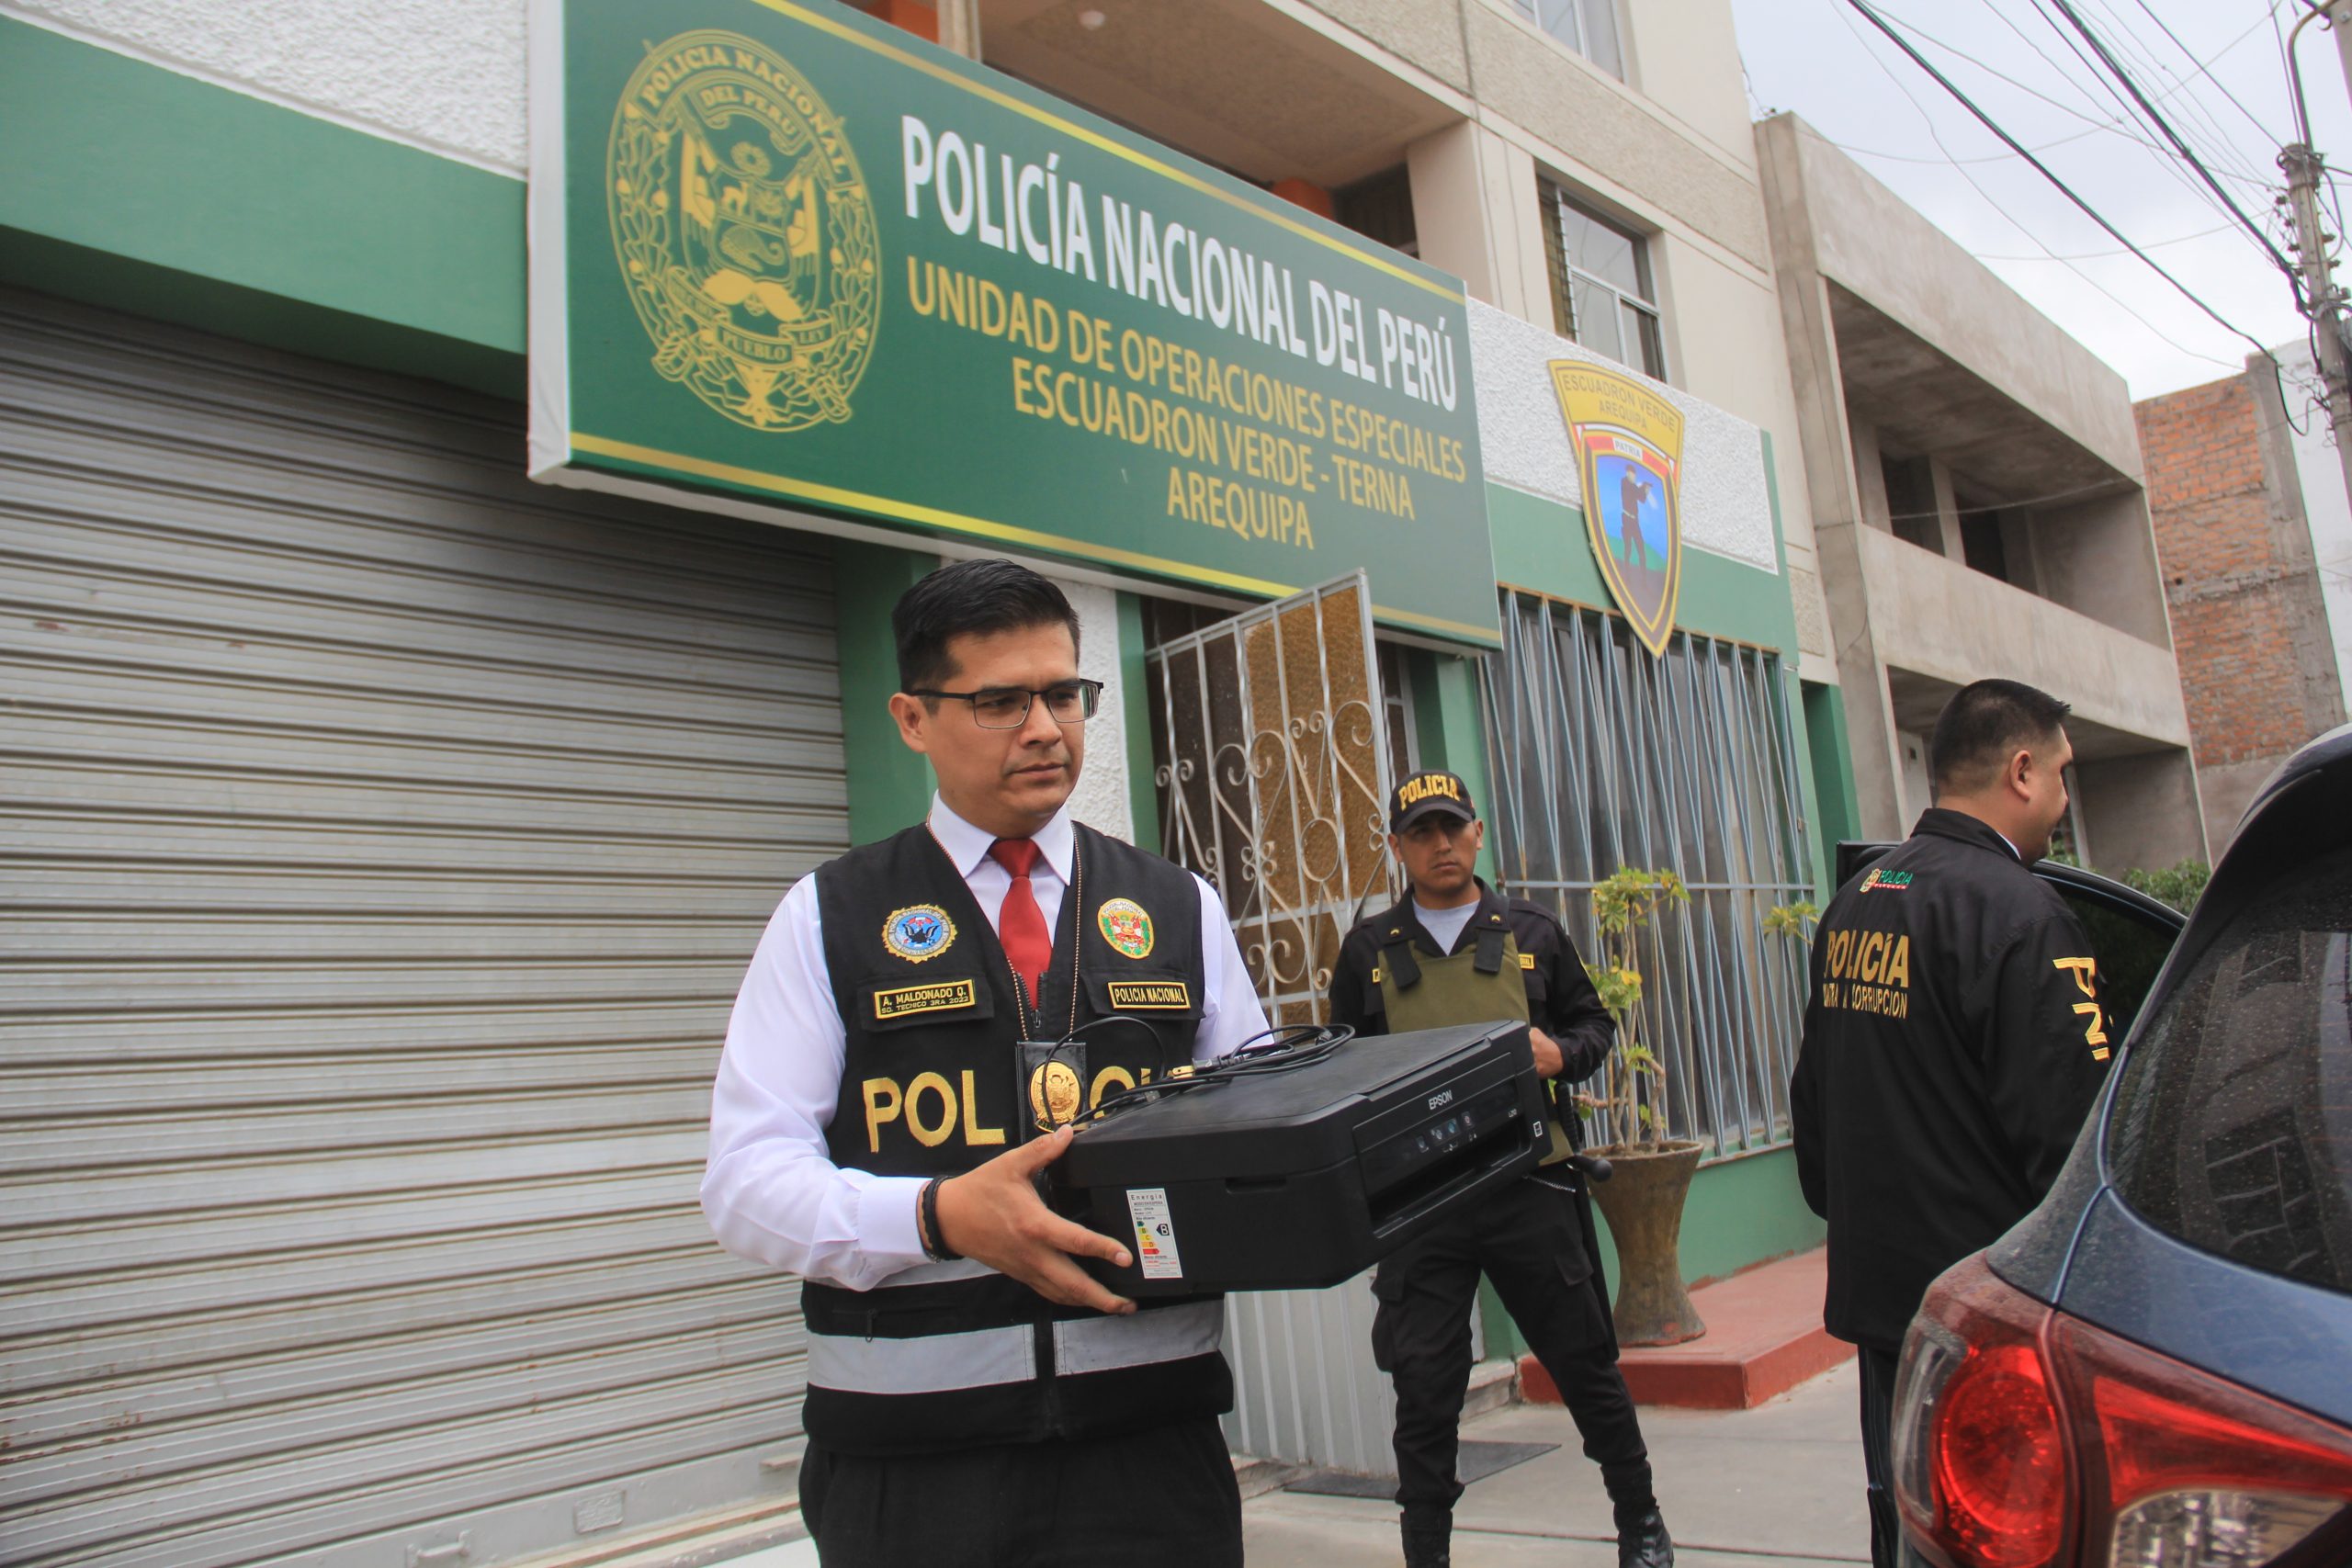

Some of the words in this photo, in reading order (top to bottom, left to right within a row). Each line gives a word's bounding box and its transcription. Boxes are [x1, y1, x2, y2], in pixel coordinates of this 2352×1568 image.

[641, 46, 729, 107] POLICIA
[734, 49, 847, 175] NACIONAL
[700, 85, 739, 107] DEL
[743, 88, 797, 135] PERU
[901, 115, 1097, 282] POLICÍA
[1102, 194, 1308, 359] NACIONAL
[1309, 279, 1376, 385] DEL
[1378, 308, 1457, 412] PERÚ
[907, 255, 1060, 353] UNIDAD
[1067, 309, 1115, 373] DE
[1120, 329, 1326, 439] OPERACIONES
[1329, 399, 1466, 483] ESPECIALES
[1562, 374, 1635, 407] ESCUADRON
[1637, 398, 1677, 434] VERDE
[1599, 400, 1647, 430] AREQUIPA
[1012, 356, 1219, 466] ESCUADRON
[1222, 421, 1317, 493] VERDE
[1332, 453, 1416, 521] TERNA
[1614, 440, 1642, 457] PATRIA
[1167, 467, 1315, 550] AREQUIPA
[1398, 774, 1462, 812] POLICIA
[1823, 929, 1910, 988] POLICÍA
[882, 996, 893, 1008] A.
[896, 987, 953, 1005] MALDONADO
[956, 986, 967, 997] Q.
[896, 1000, 928, 1011] TECNICO
[1114, 987, 1147, 1003] POLICIA
[1146, 987, 1185, 1003] NACIONAL
[1851, 983, 1908, 1020] CORRUPCION
[1428, 1089, 1453, 1111] EPSON
[1160, 1224, 1169, 1235] B
